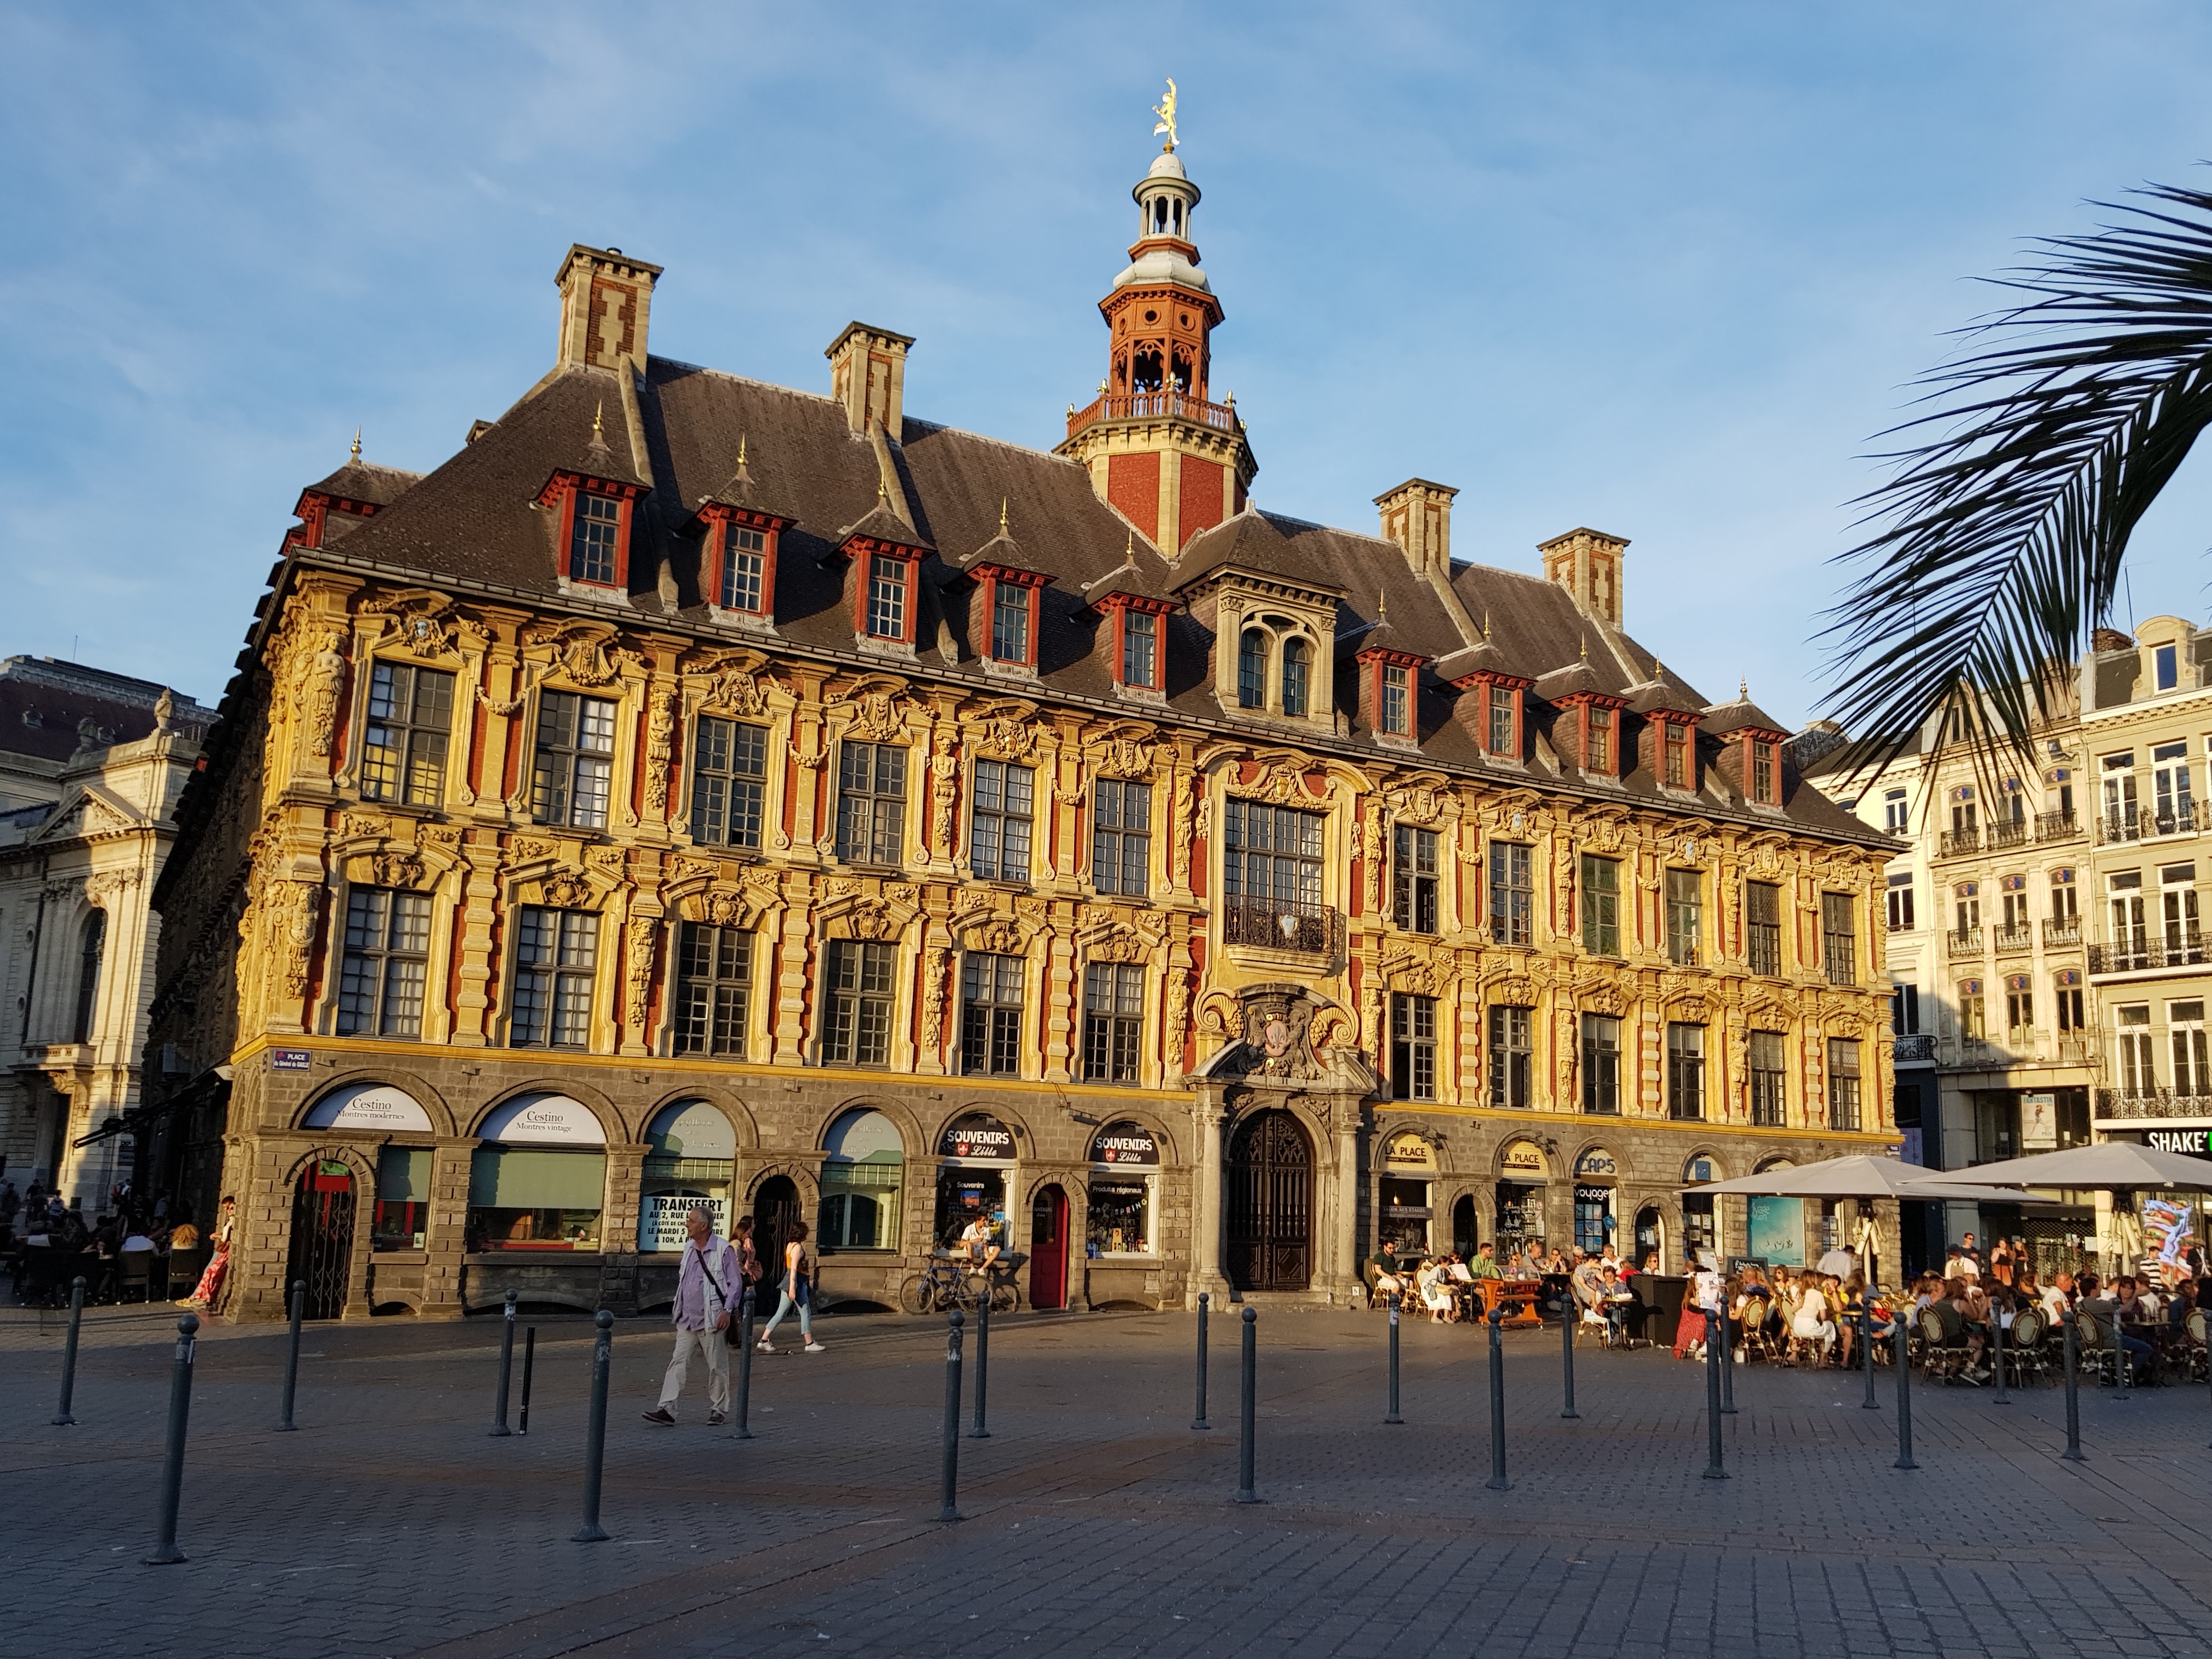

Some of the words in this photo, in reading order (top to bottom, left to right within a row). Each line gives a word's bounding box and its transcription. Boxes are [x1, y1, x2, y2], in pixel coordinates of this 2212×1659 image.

[352, 1098, 392, 1110] Cestino
[336, 1110, 368, 1118] Montres
[527, 1110, 563, 1122] Cestino
[516, 1122, 546, 1130] Montres
[547, 1124, 572, 1133] vintage
[947, 1130, 1009, 1145] SOUVENIRS
[2148, 1131, 2212, 1152] SHAKE'
[1096, 1137, 1153, 1151] SOUVENIRS
[970, 1145, 997, 1156] Lille
[1385, 1146, 1396, 1155] LA
[1400, 1147, 1426, 1156] PLACE
[1117, 1152, 1142, 1163] Lille
[1500, 1153, 1511, 1161] LA
[1515, 1153, 1540, 1163] PLACE
[1116, 1186, 1142, 1194] régionaux
[1574, 1188, 1610, 1201] voyage
[652, 1198, 723, 1211] TRANSFERT
[1114, 1198, 1148, 1216] SPRING
[678, 1235, 683, 1243] À
